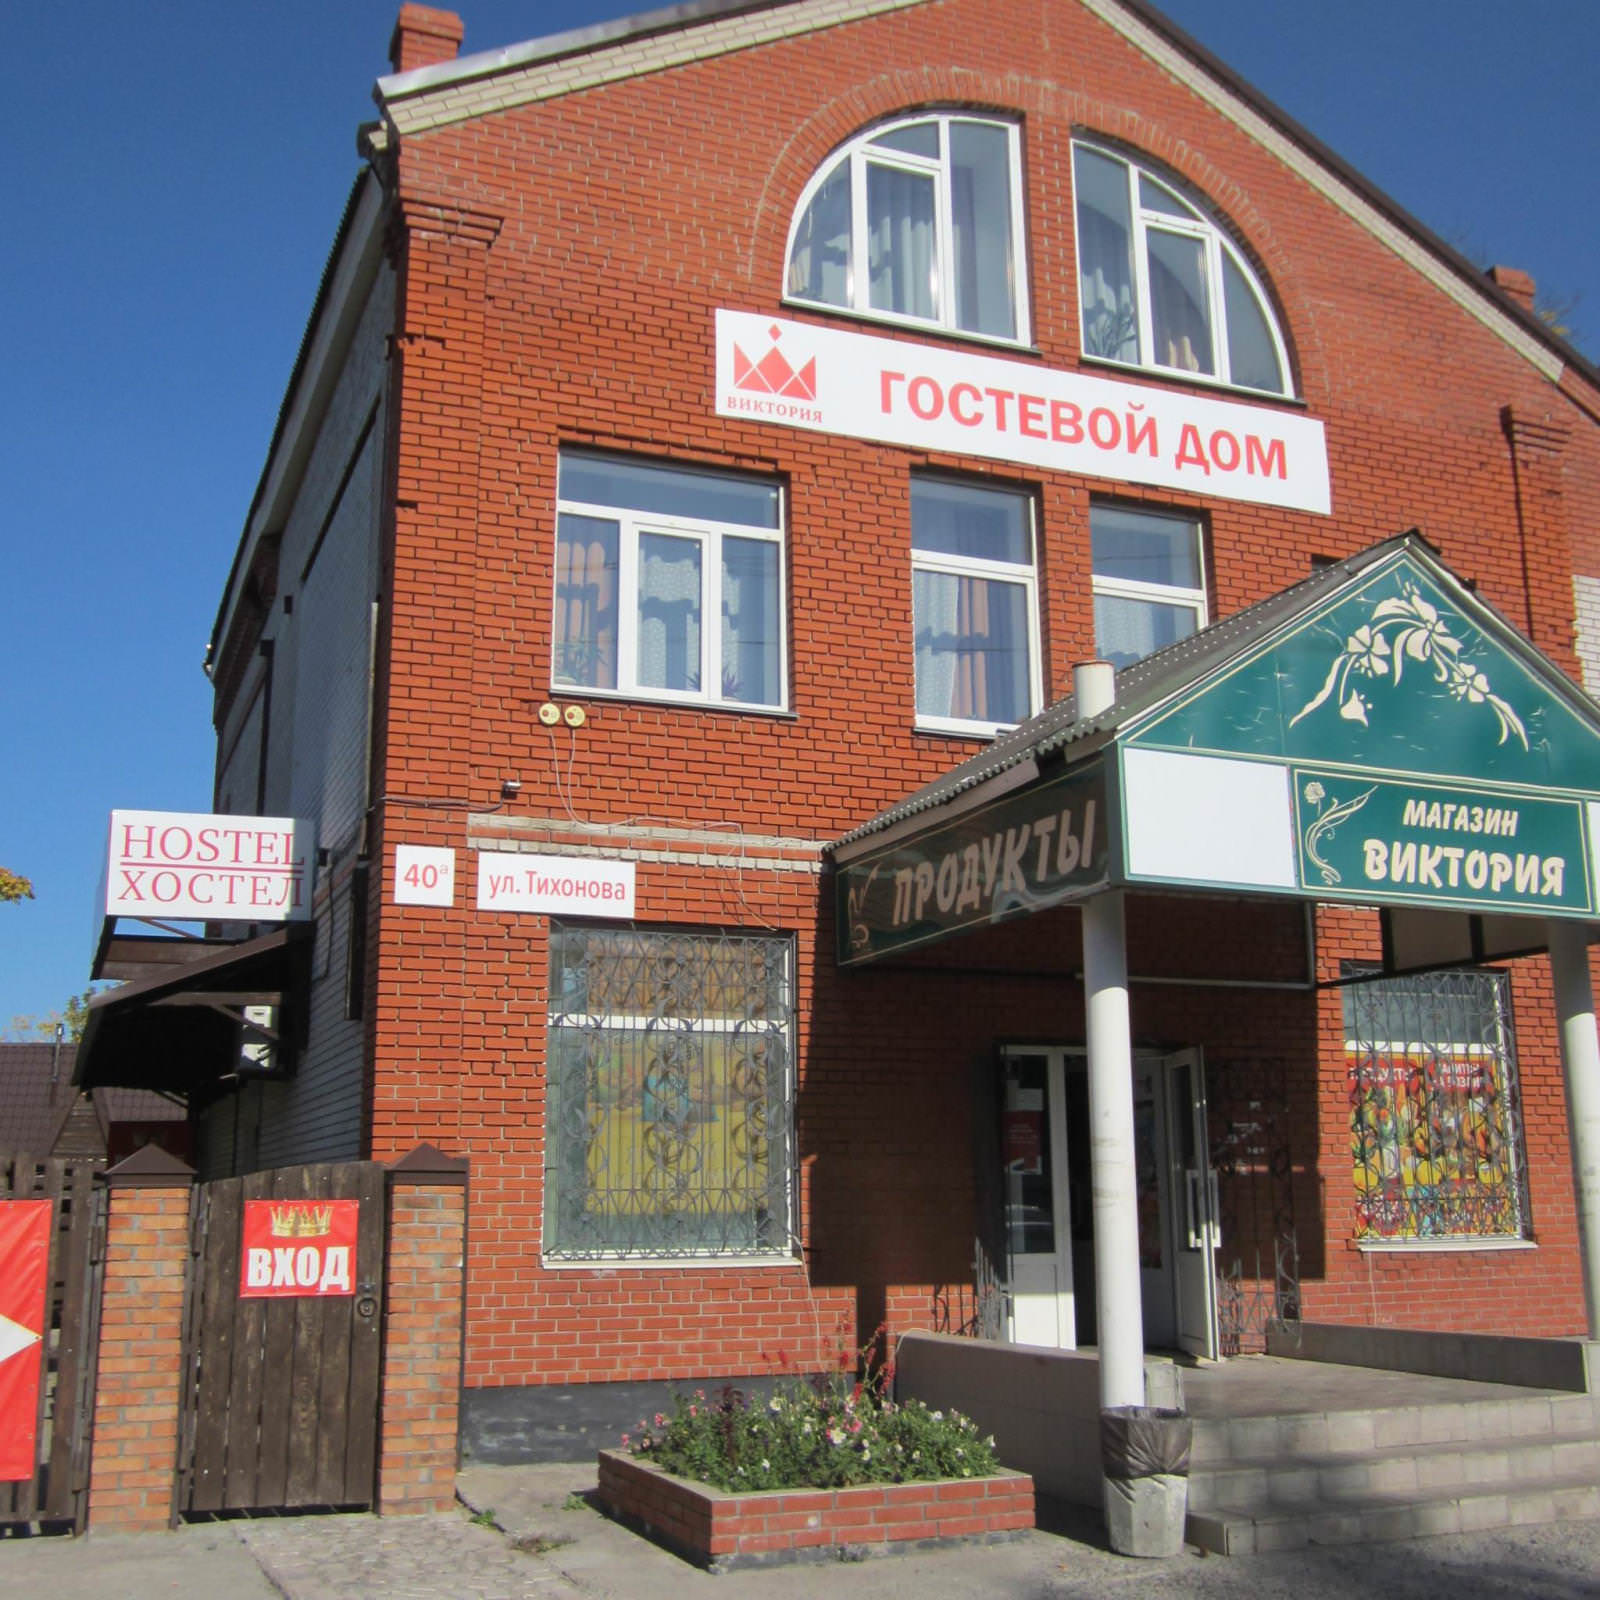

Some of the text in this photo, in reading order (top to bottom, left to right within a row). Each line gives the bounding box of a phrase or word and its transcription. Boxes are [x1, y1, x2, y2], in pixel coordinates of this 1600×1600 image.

[727, 396, 823, 424] ВИКТОРИЯ
[879, 369, 1288, 481] ГОСТЕВОЙ ДОМ
[1402, 799, 1519, 837] МАГАЗИН
[120, 824, 305, 866] HOSTEL
[891, 799, 1096, 926] ПРОДУКТЫ
[117, 870, 304, 907] ХОСТЕЛ
[1362, 838, 1566, 897] ВИКТОРИЯ
[247, 1246, 350, 1291] ВХОД
